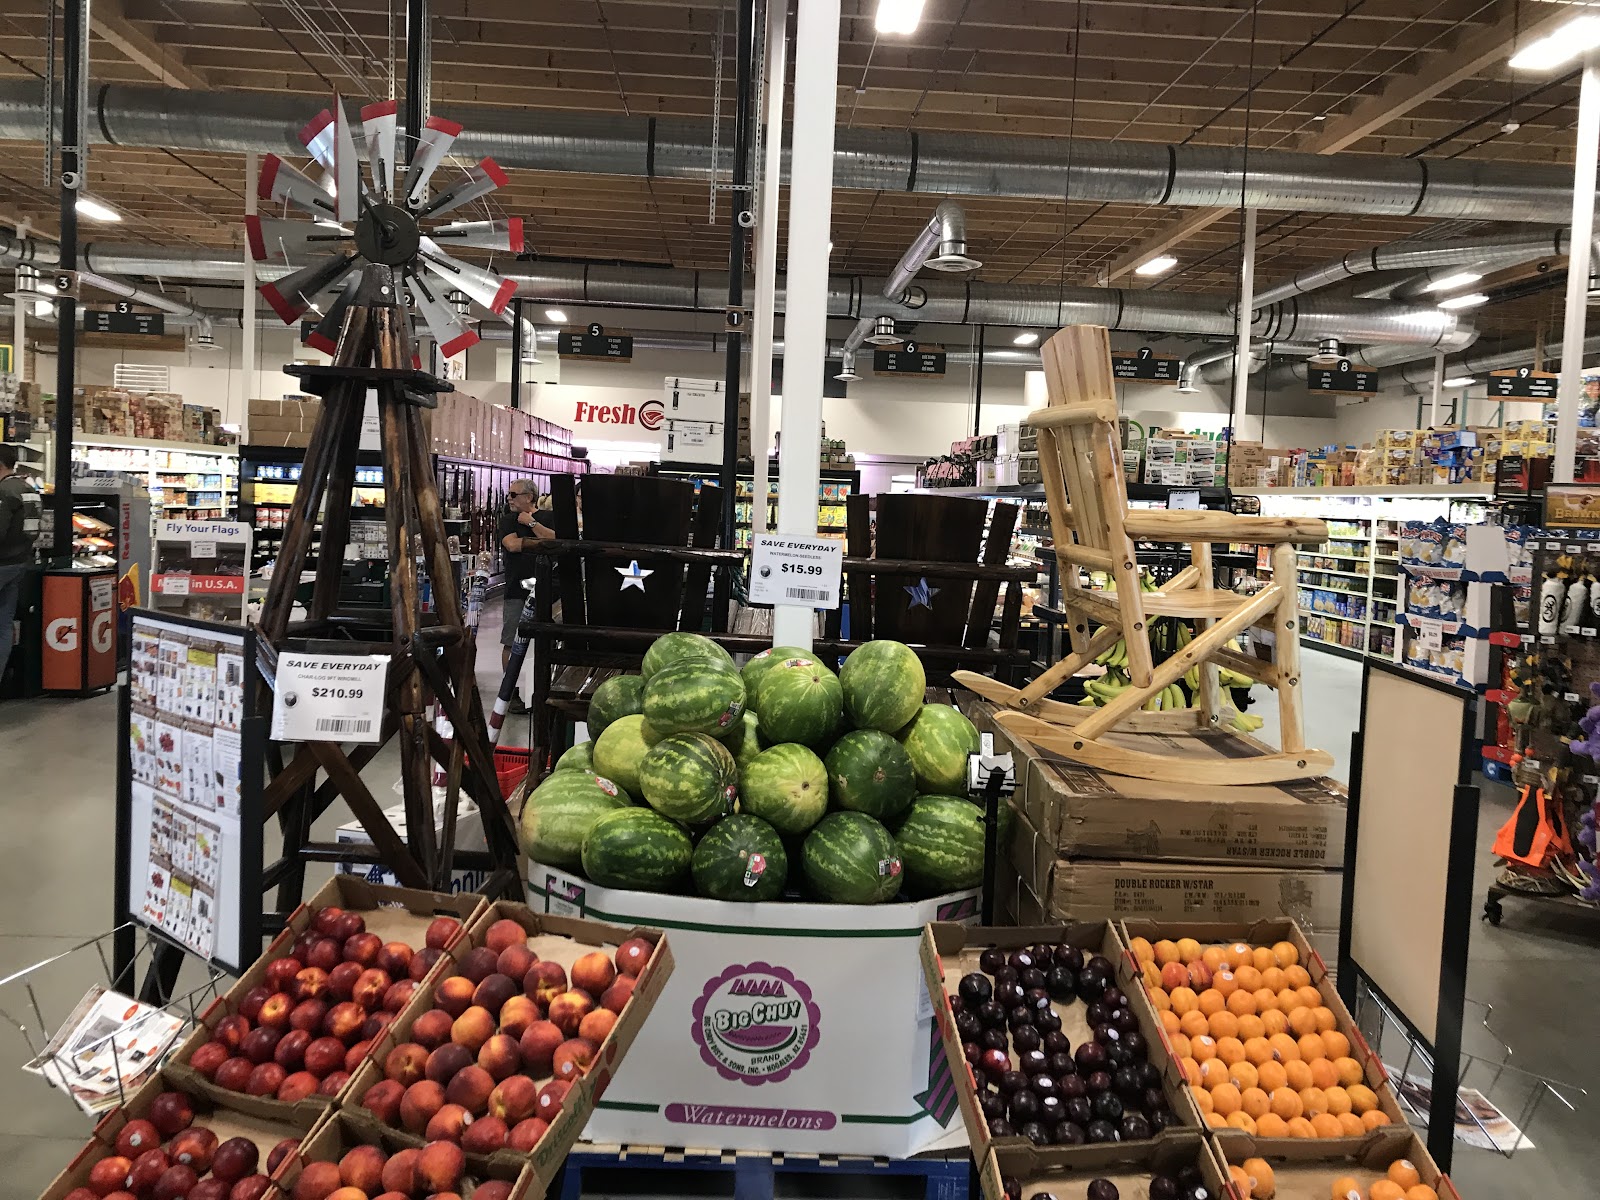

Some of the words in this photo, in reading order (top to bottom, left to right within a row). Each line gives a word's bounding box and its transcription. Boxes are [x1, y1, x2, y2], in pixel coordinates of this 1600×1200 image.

[59, 277, 68, 289] 3
[404, 294, 411, 307] 2
[119, 302, 128, 314] 3
[732, 313, 738, 325] 1
[591, 326, 600, 337] 5
[906, 342, 915, 353] 6
[1141, 349, 1150, 360] 7
[1340, 361, 1348, 372] 8
[1519, 368, 1529, 378] 9
[573, 401, 636, 425] Fresh
[122, 503, 130, 530] Bull
[166, 523, 182, 534] Fly
[185, 523, 209, 533] Your
[211, 525, 240, 536] Flags
[122, 532, 130, 560] Red
[760, 539, 786, 548] SAVE
[787, 542, 837, 553] EVERYDAY
[781, 563, 823, 576] $15.99
[192, 580, 202, 588] in
[205, 580, 238, 589] U.S.A.
[45, 617, 77, 652] G
[91, 610, 112, 653] G
[286, 660, 318, 669] SAVE
[321, 662, 381, 671] EVERYDAY
[311, 687, 364, 699] $210.99
[1226, 846, 1257, 857] W/STAR
[1260, 847, 1291, 858] ROCKER
[1293, 849, 1326, 859] DOUBLE
[1114, 878, 1147, 889] DOUBLE
[1149, 879, 1181, 889] ROCKER
[1183, 879, 1214, 890] W/STAR
[715, 1009, 751, 1033] BIG
[752, 1000, 802, 1025] CHUY
[748, 1066, 761, 1074] INC.
[766, 1053, 795, 1073] NOGALES,
[792, 1044, 801, 1054] AZ
[751, 1053, 780, 1065] BRAND
[683, 1104, 823, 1130] Watermelons
